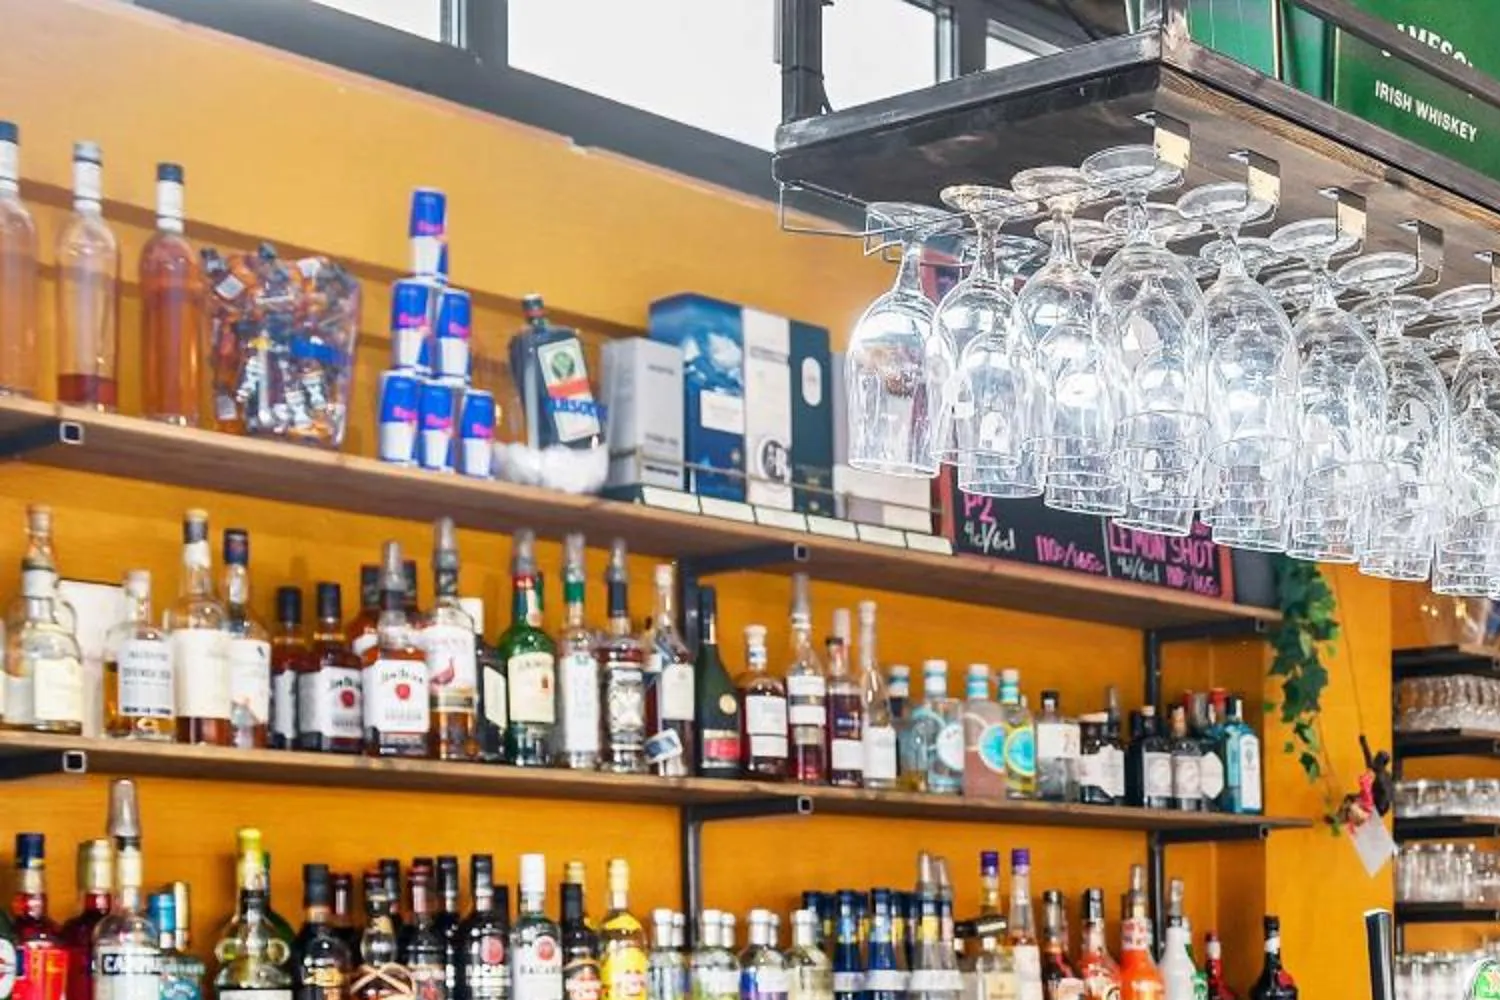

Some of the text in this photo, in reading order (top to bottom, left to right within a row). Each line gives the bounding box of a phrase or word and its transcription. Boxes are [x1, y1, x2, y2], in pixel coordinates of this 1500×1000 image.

[1375, 80, 1477, 142] IRISH WHISKEY
[1170, 537, 1215, 571] SHOT
